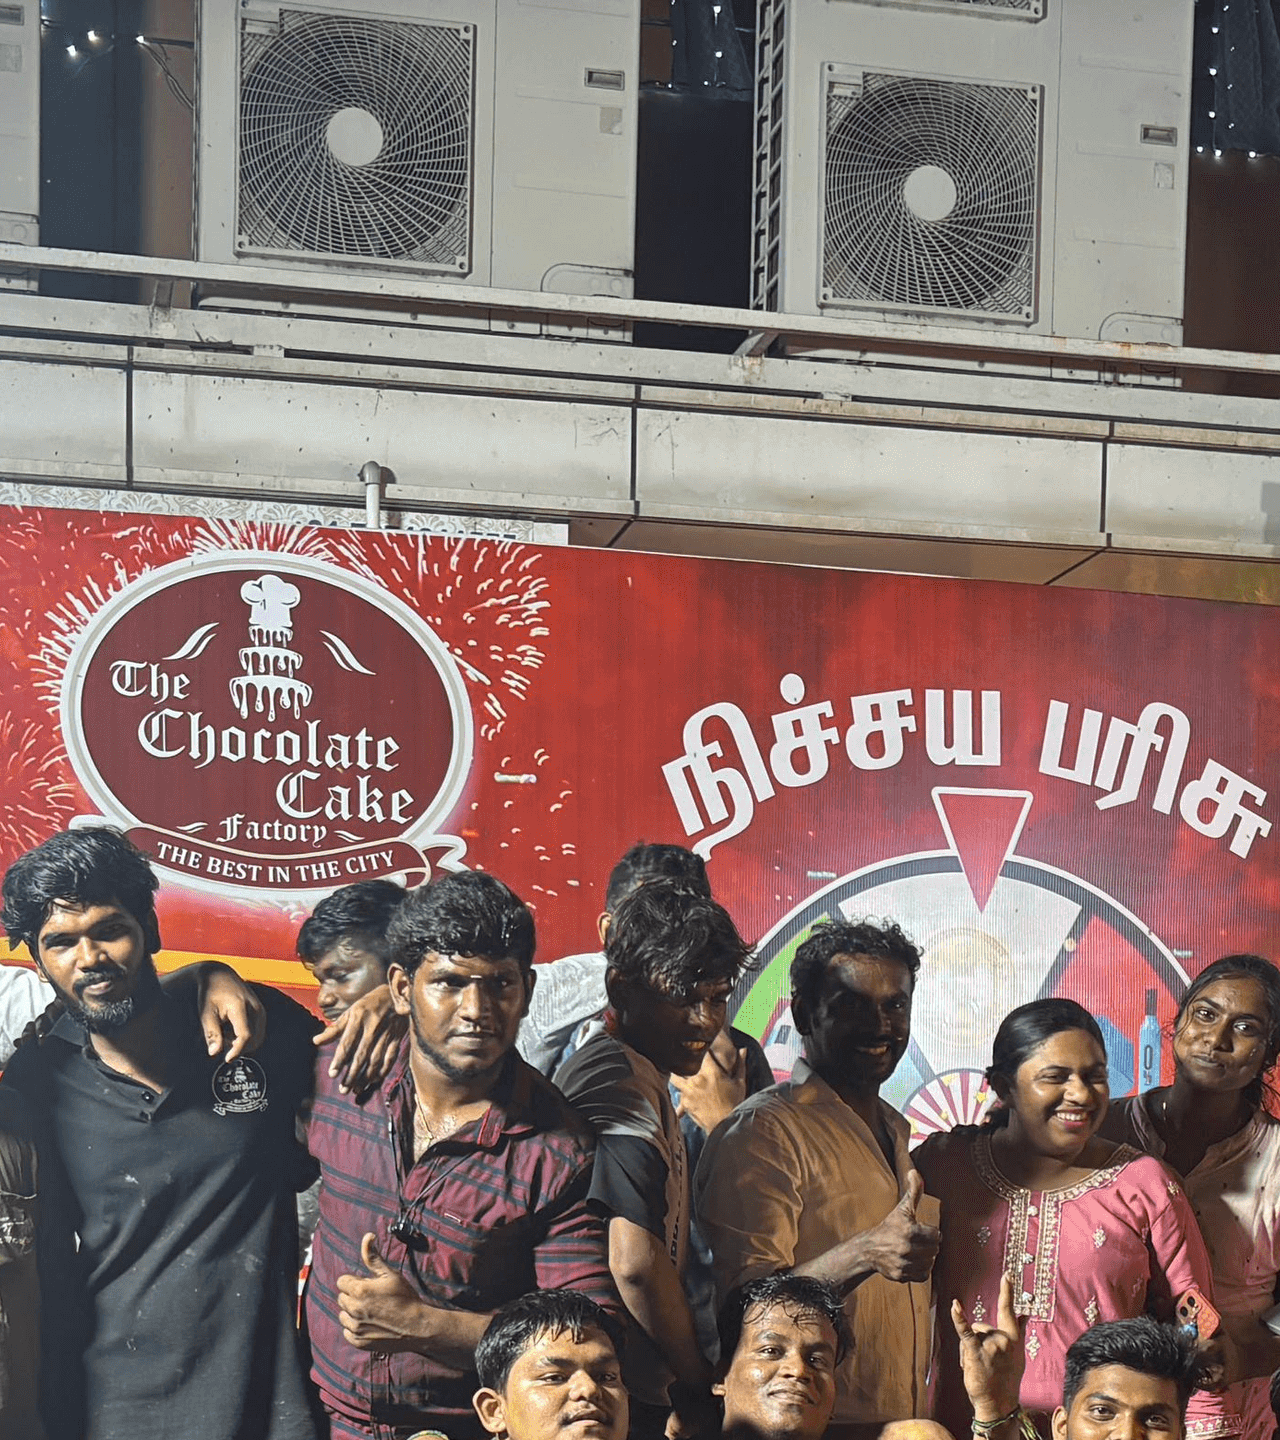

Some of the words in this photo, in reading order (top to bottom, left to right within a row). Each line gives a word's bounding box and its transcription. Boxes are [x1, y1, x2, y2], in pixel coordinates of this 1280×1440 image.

[109, 660, 191, 705] The
[137, 708, 401, 772] Chocolate
[661, 673, 1001, 861] நிச்சய
[1038, 699, 1273, 859] பரிசு
[275, 769, 415, 825] Cake
[215, 813, 328, 848] Factory
[157, 841, 203, 870] THE
[206, 855, 263, 882] BEST
[268, 866, 291, 884] IN
[295, 860, 341, 883] THE
[345, 849, 395, 875] CITY
